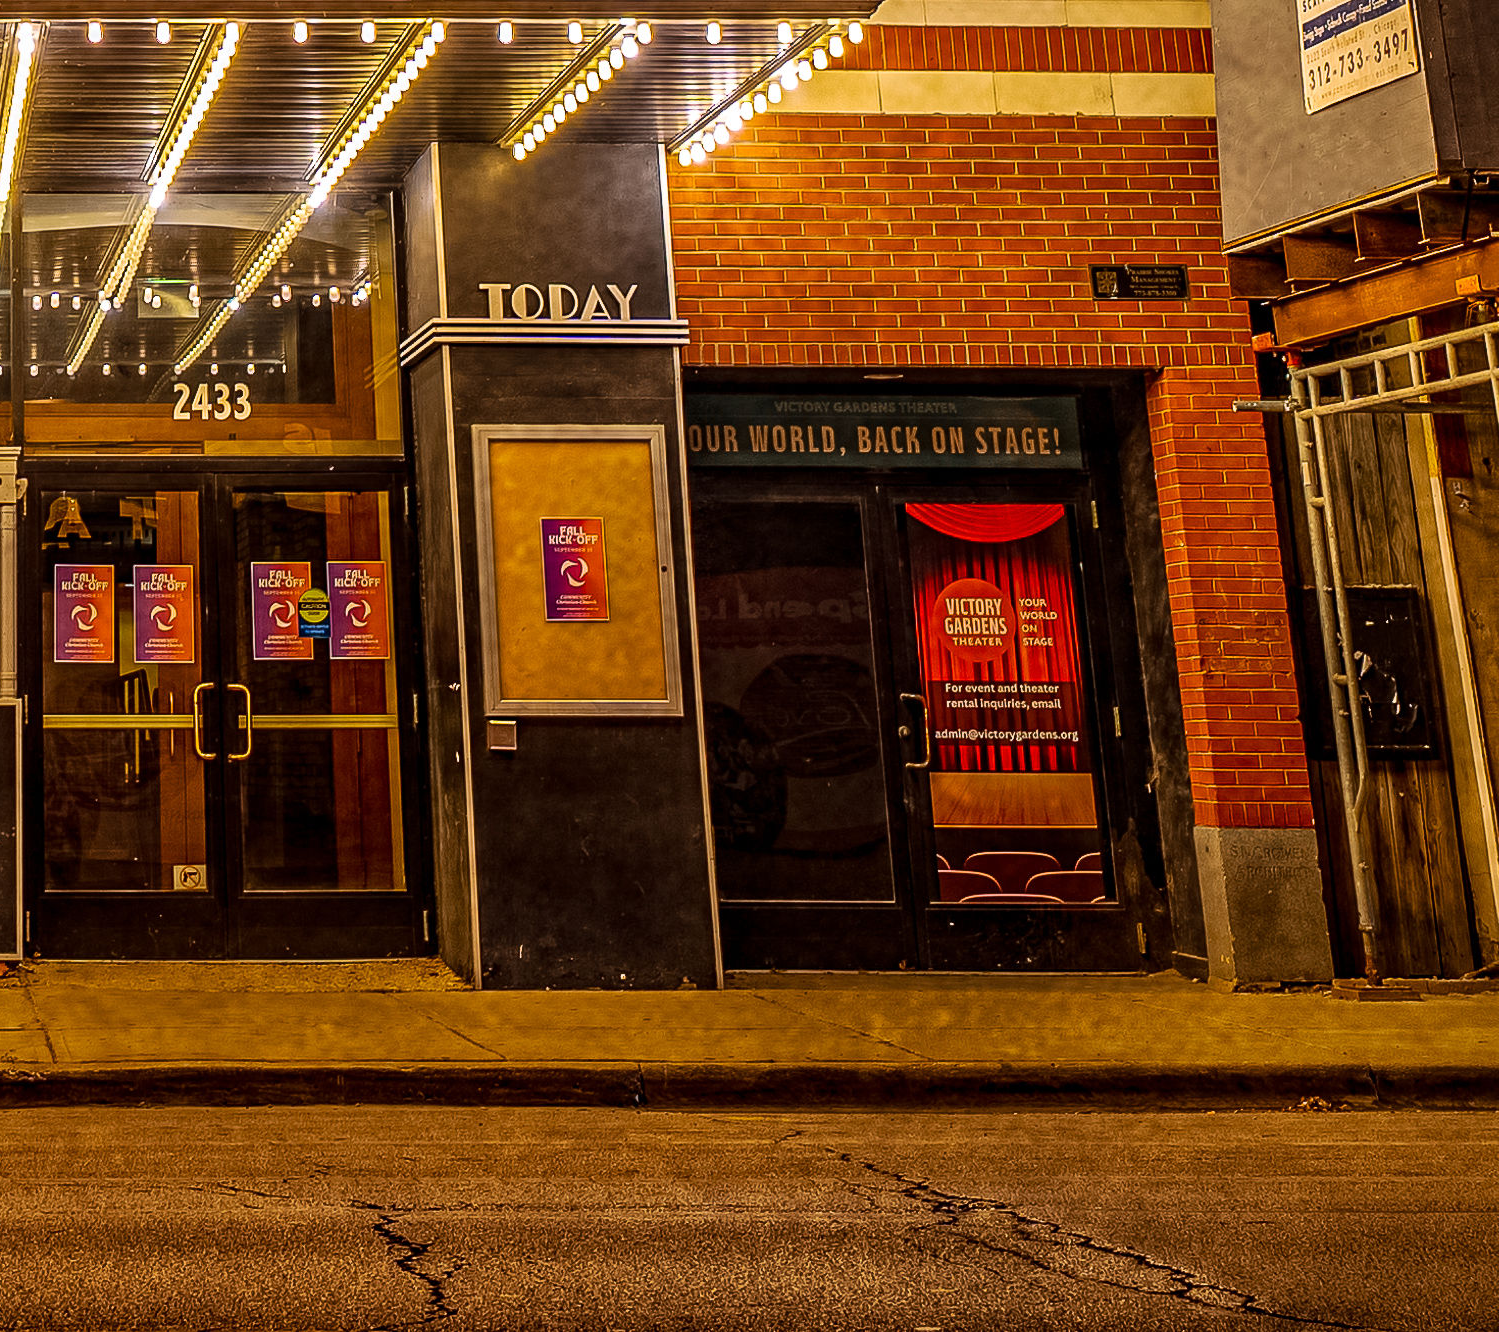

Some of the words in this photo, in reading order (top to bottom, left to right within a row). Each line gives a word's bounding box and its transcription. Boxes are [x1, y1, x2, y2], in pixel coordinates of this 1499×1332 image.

[1309, 28, 1409, 90] 312-733-3497
[478, 282, 640, 321] TODAY
[172, 382, 252, 422] 2433
[773, 401, 831, 413] VICTORY
[833, 401, 897, 413] GARDENS
[898, 402, 958, 414] THEATER
[688, 424, 740, 453] OUR
[748, 425, 846, 457] WORLD,
[857, 426, 920, 455] BACK
[931, 426, 965, 455] ON
[974, 427, 1062, 456] STAGE!
[559, 526, 586, 536] FALL
[548, 535, 599, 545] KICK-OFF
[72, 573, 98, 582] FALL
[151, 573, 176, 582] FALL
[269, 570, 294, 580] FALL
[344, 569, 369, 579] FALL
[61, 581, 109, 591] KICK-OFF
[140, 581, 188, 591] KICK-OFF
[258, 578, 306, 588] KICK-OFF
[334, 578, 381, 588] KICK-OFF
[945, 598, 1002, 616] VICTORY
[1019, 598, 1047, 607] YOUR
[1020, 611, 1058, 620] WORLD
[944, 617, 1008, 635] GARDENS
[1022, 624, 1038, 633] ON
[952, 637, 1003, 646] THEATER
[1023, 638, 1054, 646] STAGE
[945, 683, 963, 693] For
[965, 684, 995, 693] event
[997, 683, 1018, 693] and
[1020, 684, 1059, 693] theater
[947, 698, 978, 708] rental
[980, 698, 1030, 710] inquiries,
[1031, 699, 1061, 709] email
[935, 728, 1079, 742] admin@victorygardens.org
